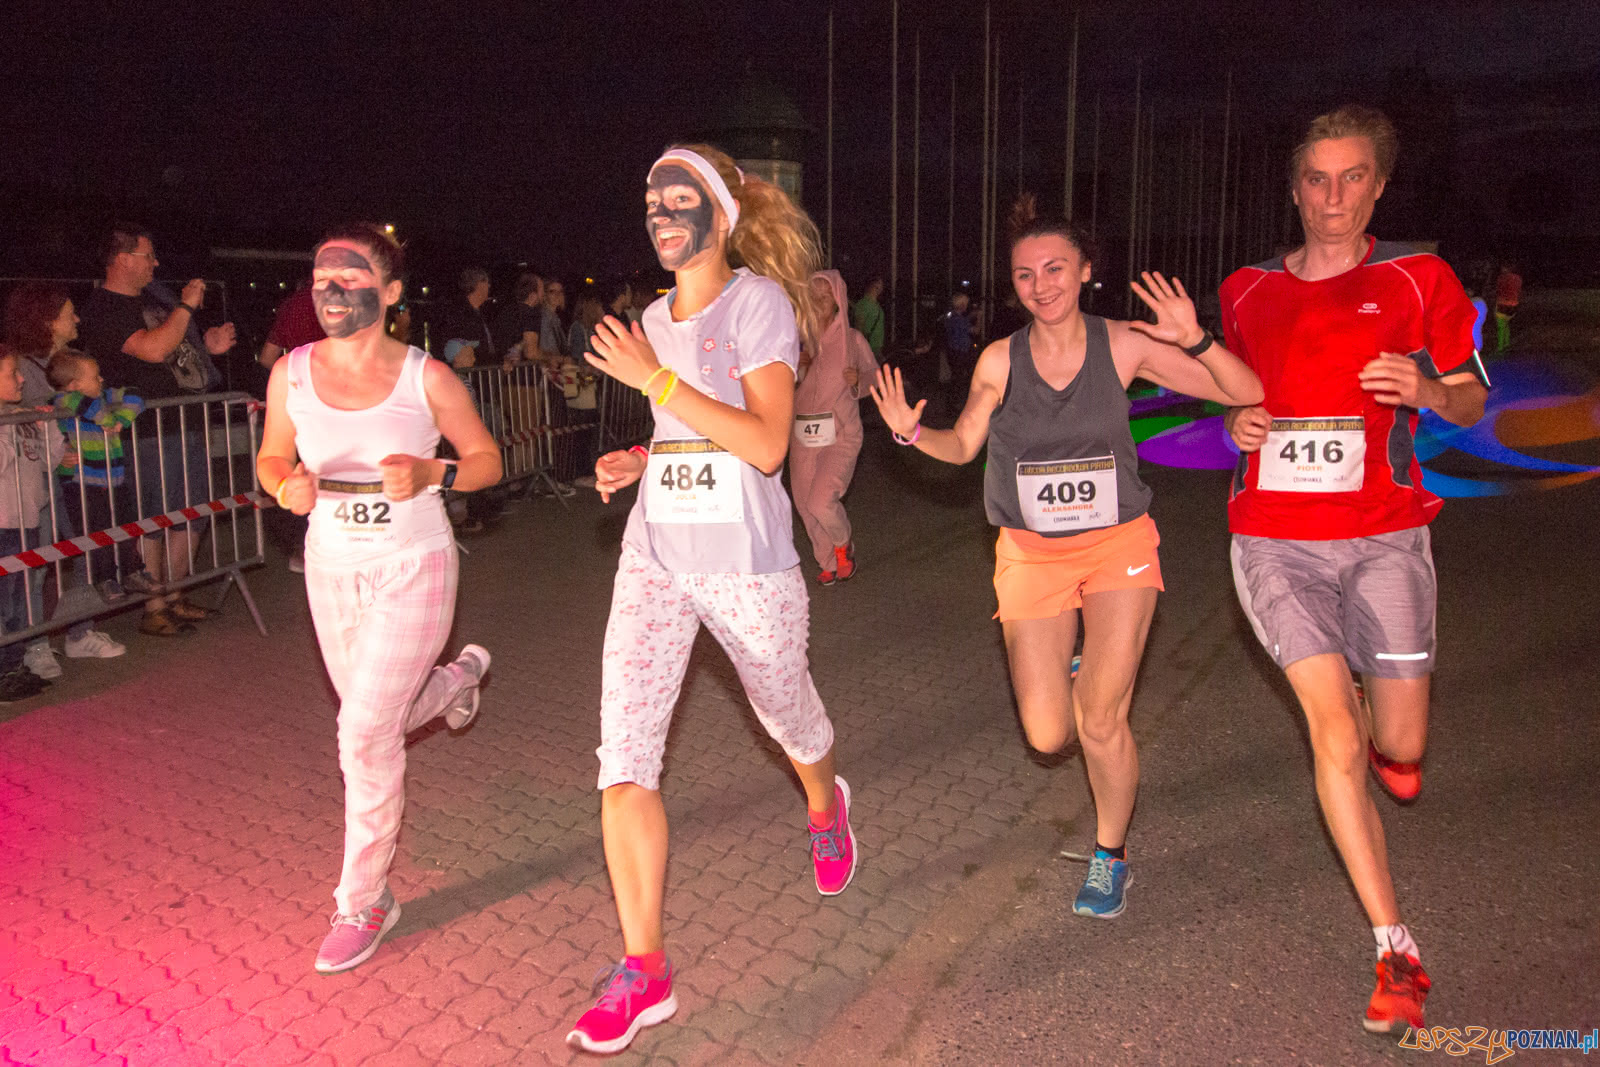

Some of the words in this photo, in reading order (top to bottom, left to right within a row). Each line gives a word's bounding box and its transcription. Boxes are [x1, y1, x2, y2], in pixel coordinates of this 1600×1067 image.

[803, 423, 820, 434] 47
[1280, 440, 1344, 464] 416
[660, 463, 716, 491] 484
[1037, 480, 1096, 505] 409
[334, 501, 391, 524] 482
[1042, 504, 1094, 513] ALEKSANDRA
